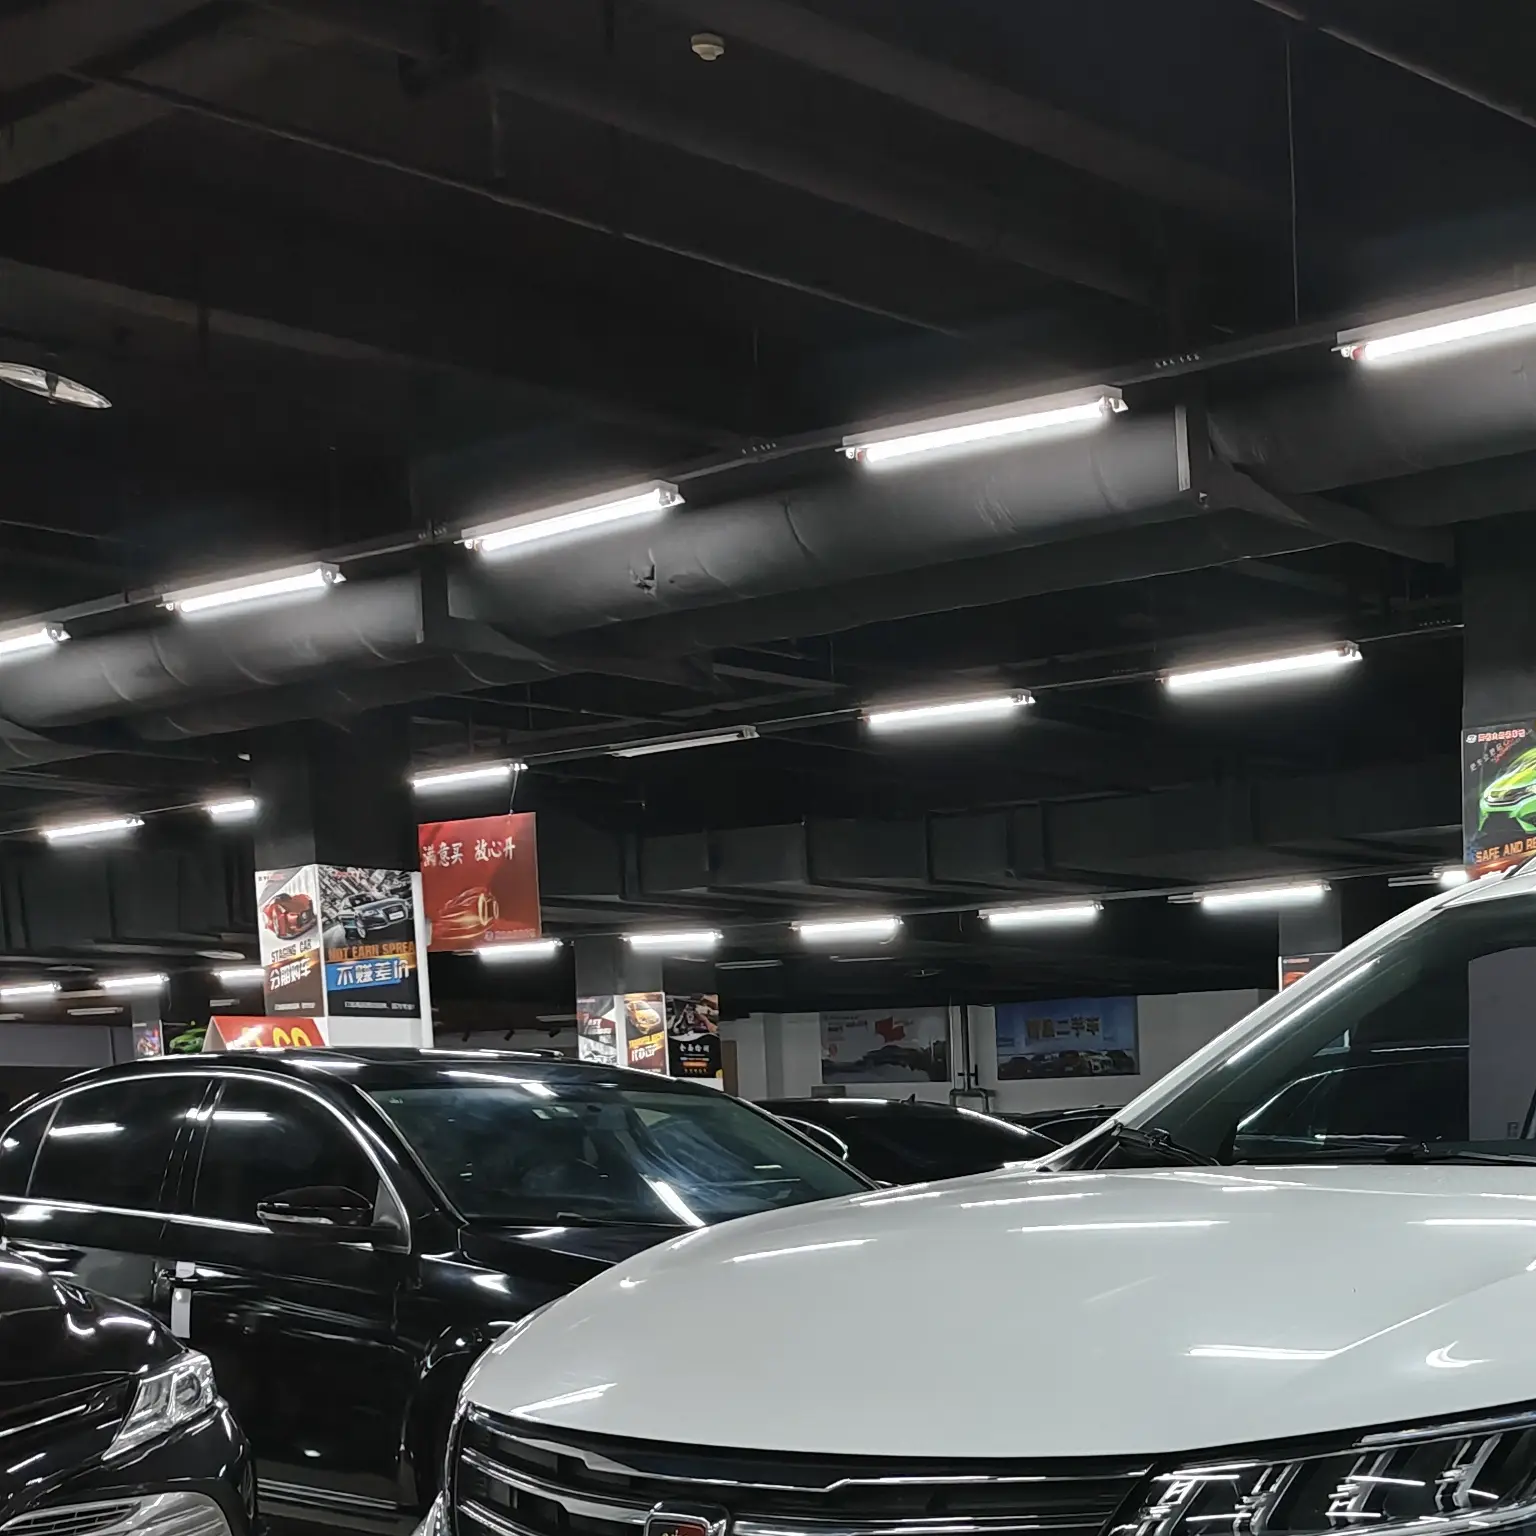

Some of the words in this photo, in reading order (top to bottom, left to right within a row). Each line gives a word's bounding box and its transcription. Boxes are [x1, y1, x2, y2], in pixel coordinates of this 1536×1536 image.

[422, 842, 463, 867] 满意买
[474, 836, 516, 861] 放心开
[1475, 847, 1500, 864] SAFE
[1503, 841, 1523, 857] AND
[328, 946, 349, 960] NOT
[353, 944, 379, 957] EARN
[336, 959, 410, 986] 不赚差价
